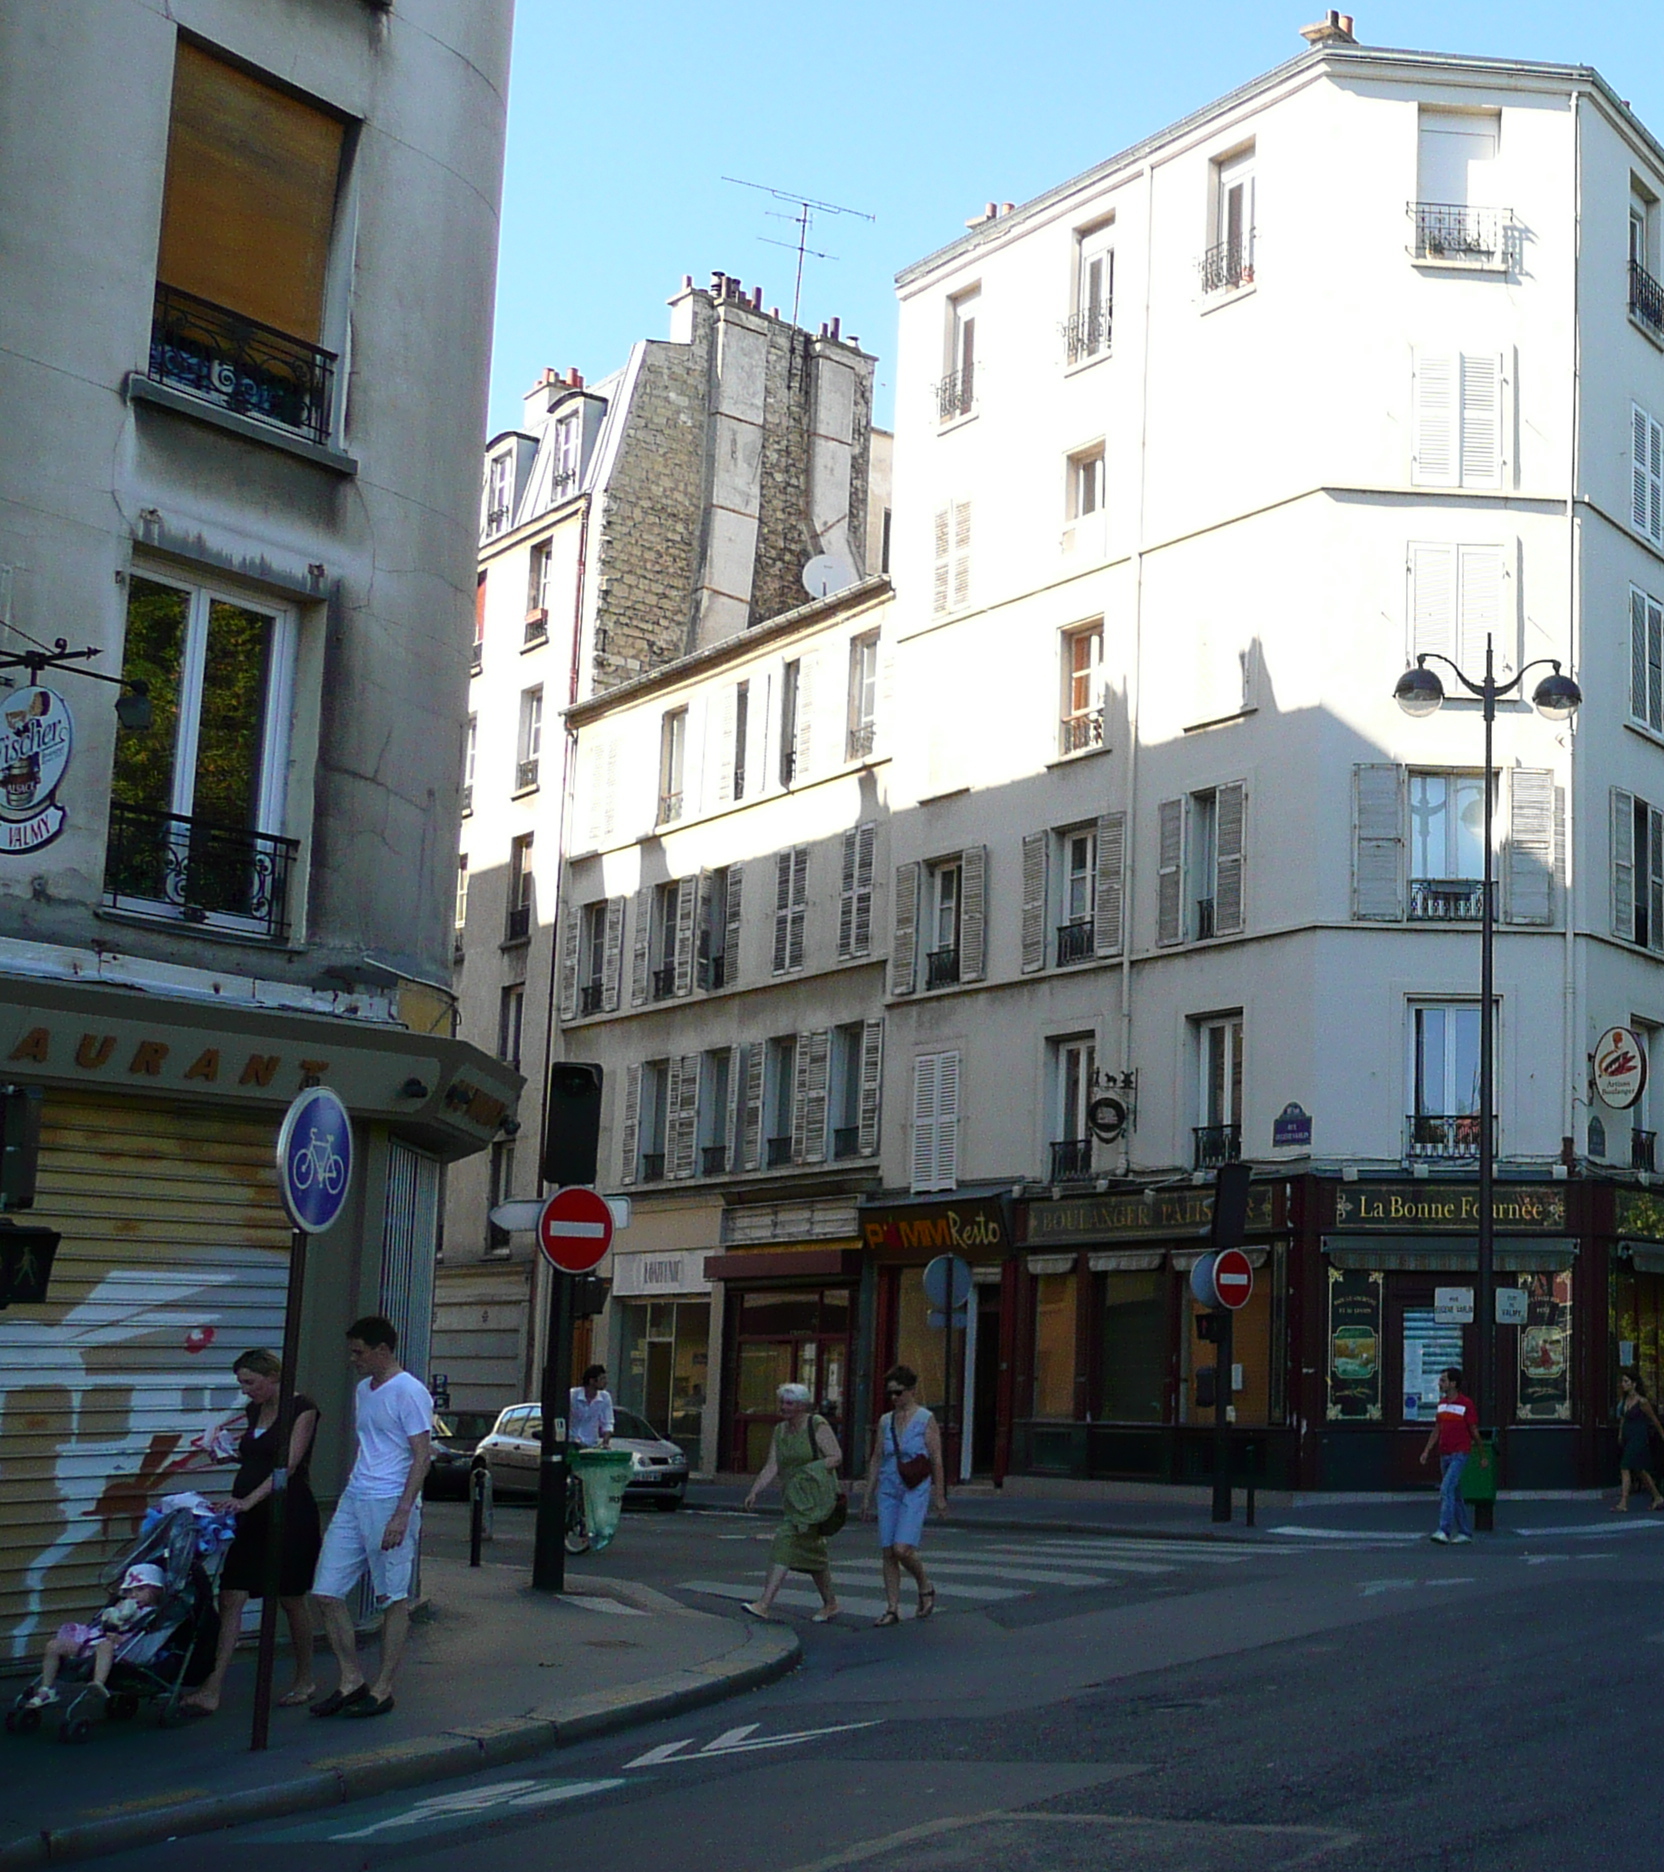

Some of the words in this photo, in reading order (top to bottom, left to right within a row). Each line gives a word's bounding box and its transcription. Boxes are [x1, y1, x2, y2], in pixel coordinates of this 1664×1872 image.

[8, 814, 52, 848] VALMY
[9, 1027, 330, 1089] AURANT
[1043, 1204, 1150, 1231] BOULANGER
[1360, 1195, 1384, 1218] La
[1390, 1195, 1454, 1219] Bonne
